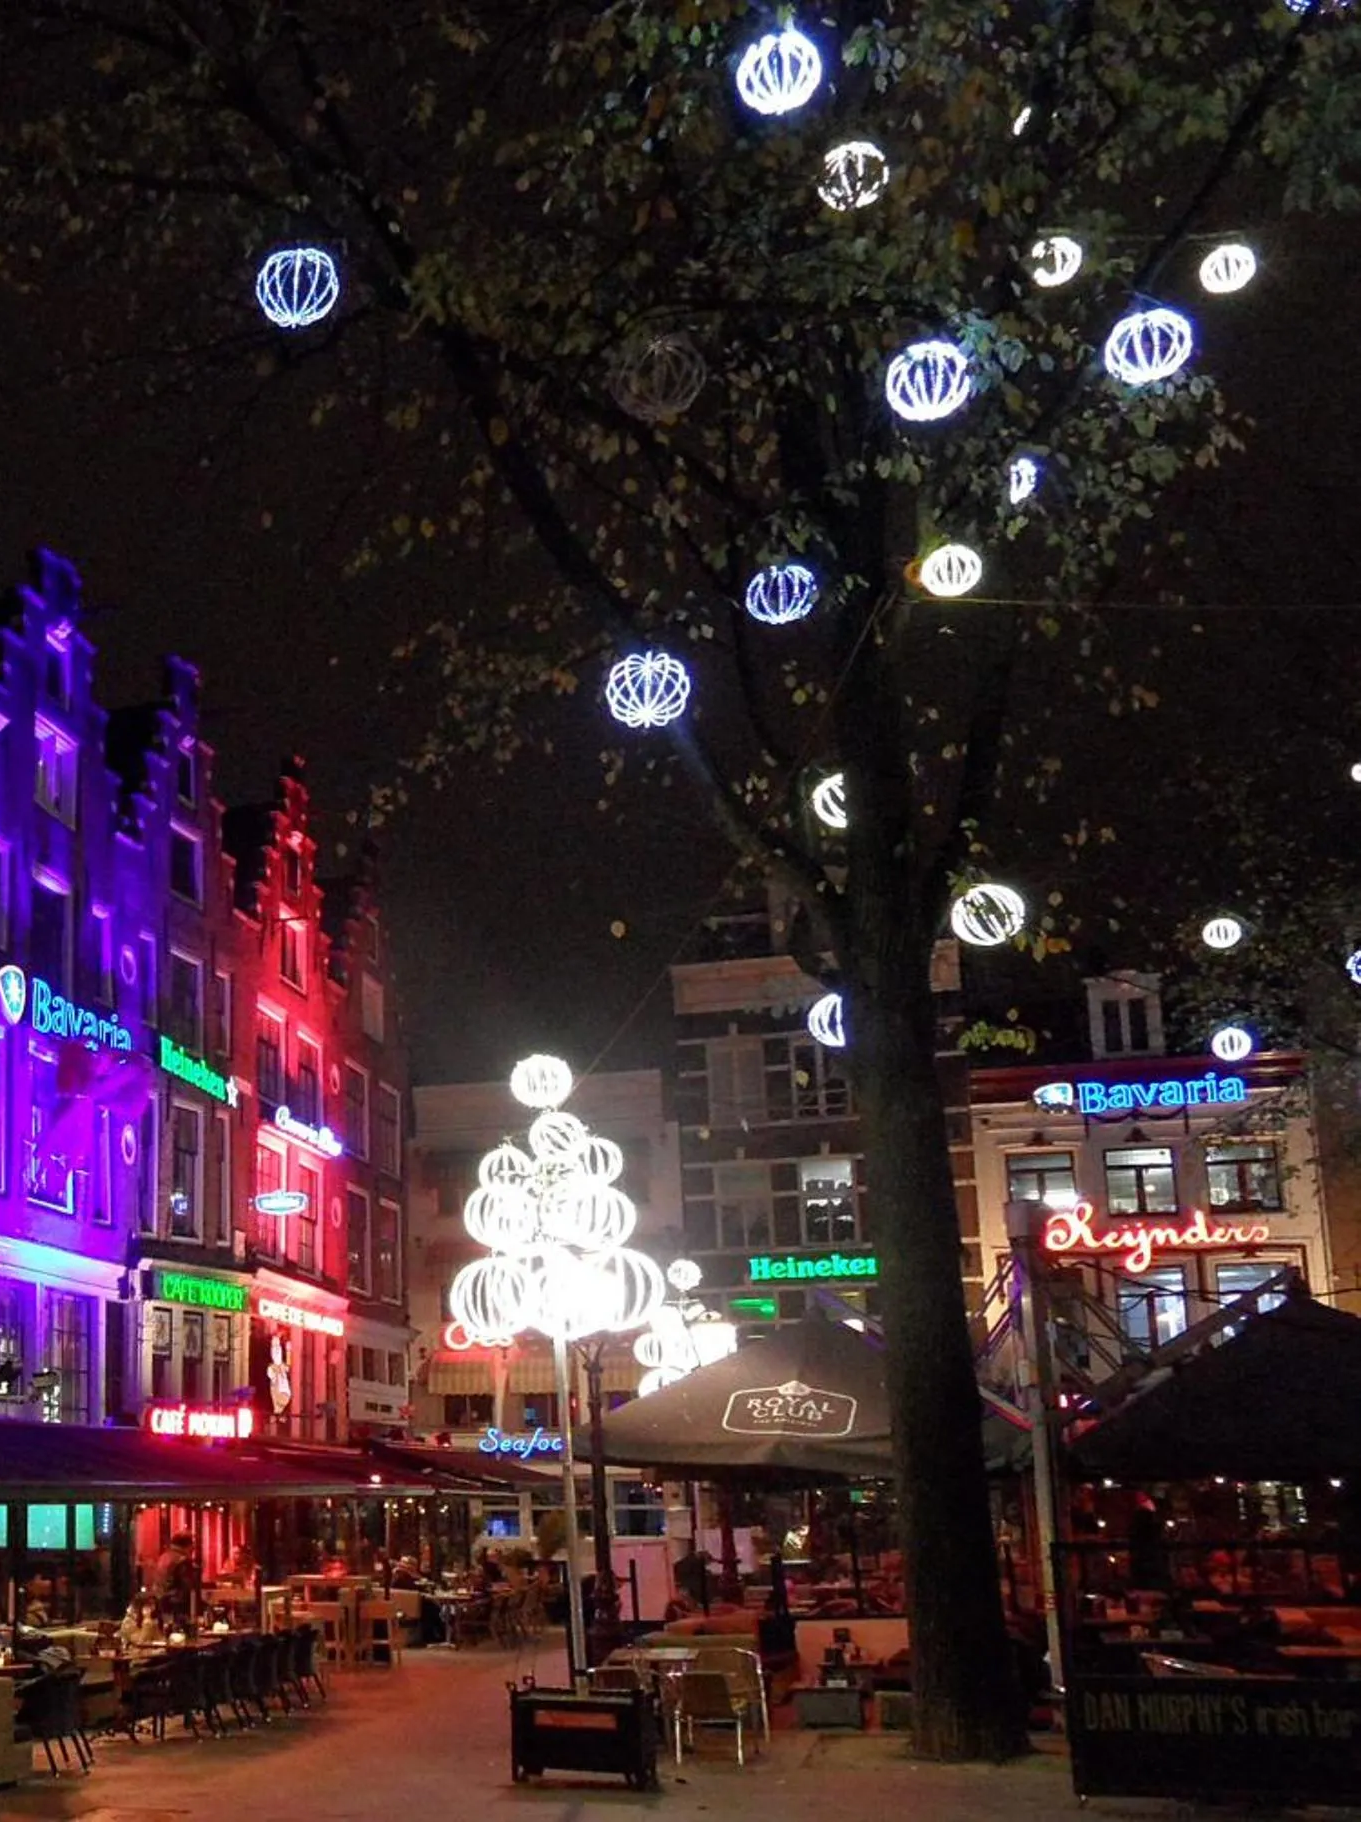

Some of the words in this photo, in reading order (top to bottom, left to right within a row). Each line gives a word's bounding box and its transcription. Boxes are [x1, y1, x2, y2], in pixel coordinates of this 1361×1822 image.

[33, 978, 132, 1051] Bavaria
[161, 1035, 227, 1101] Heineken
[1078, 1072, 1245, 1114] Bavaria
[1045, 1202, 1270, 1274] Reijnders
[747, 1396, 836, 1416] ROYAL
[1084, 1691, 1132, 1731] DAN
